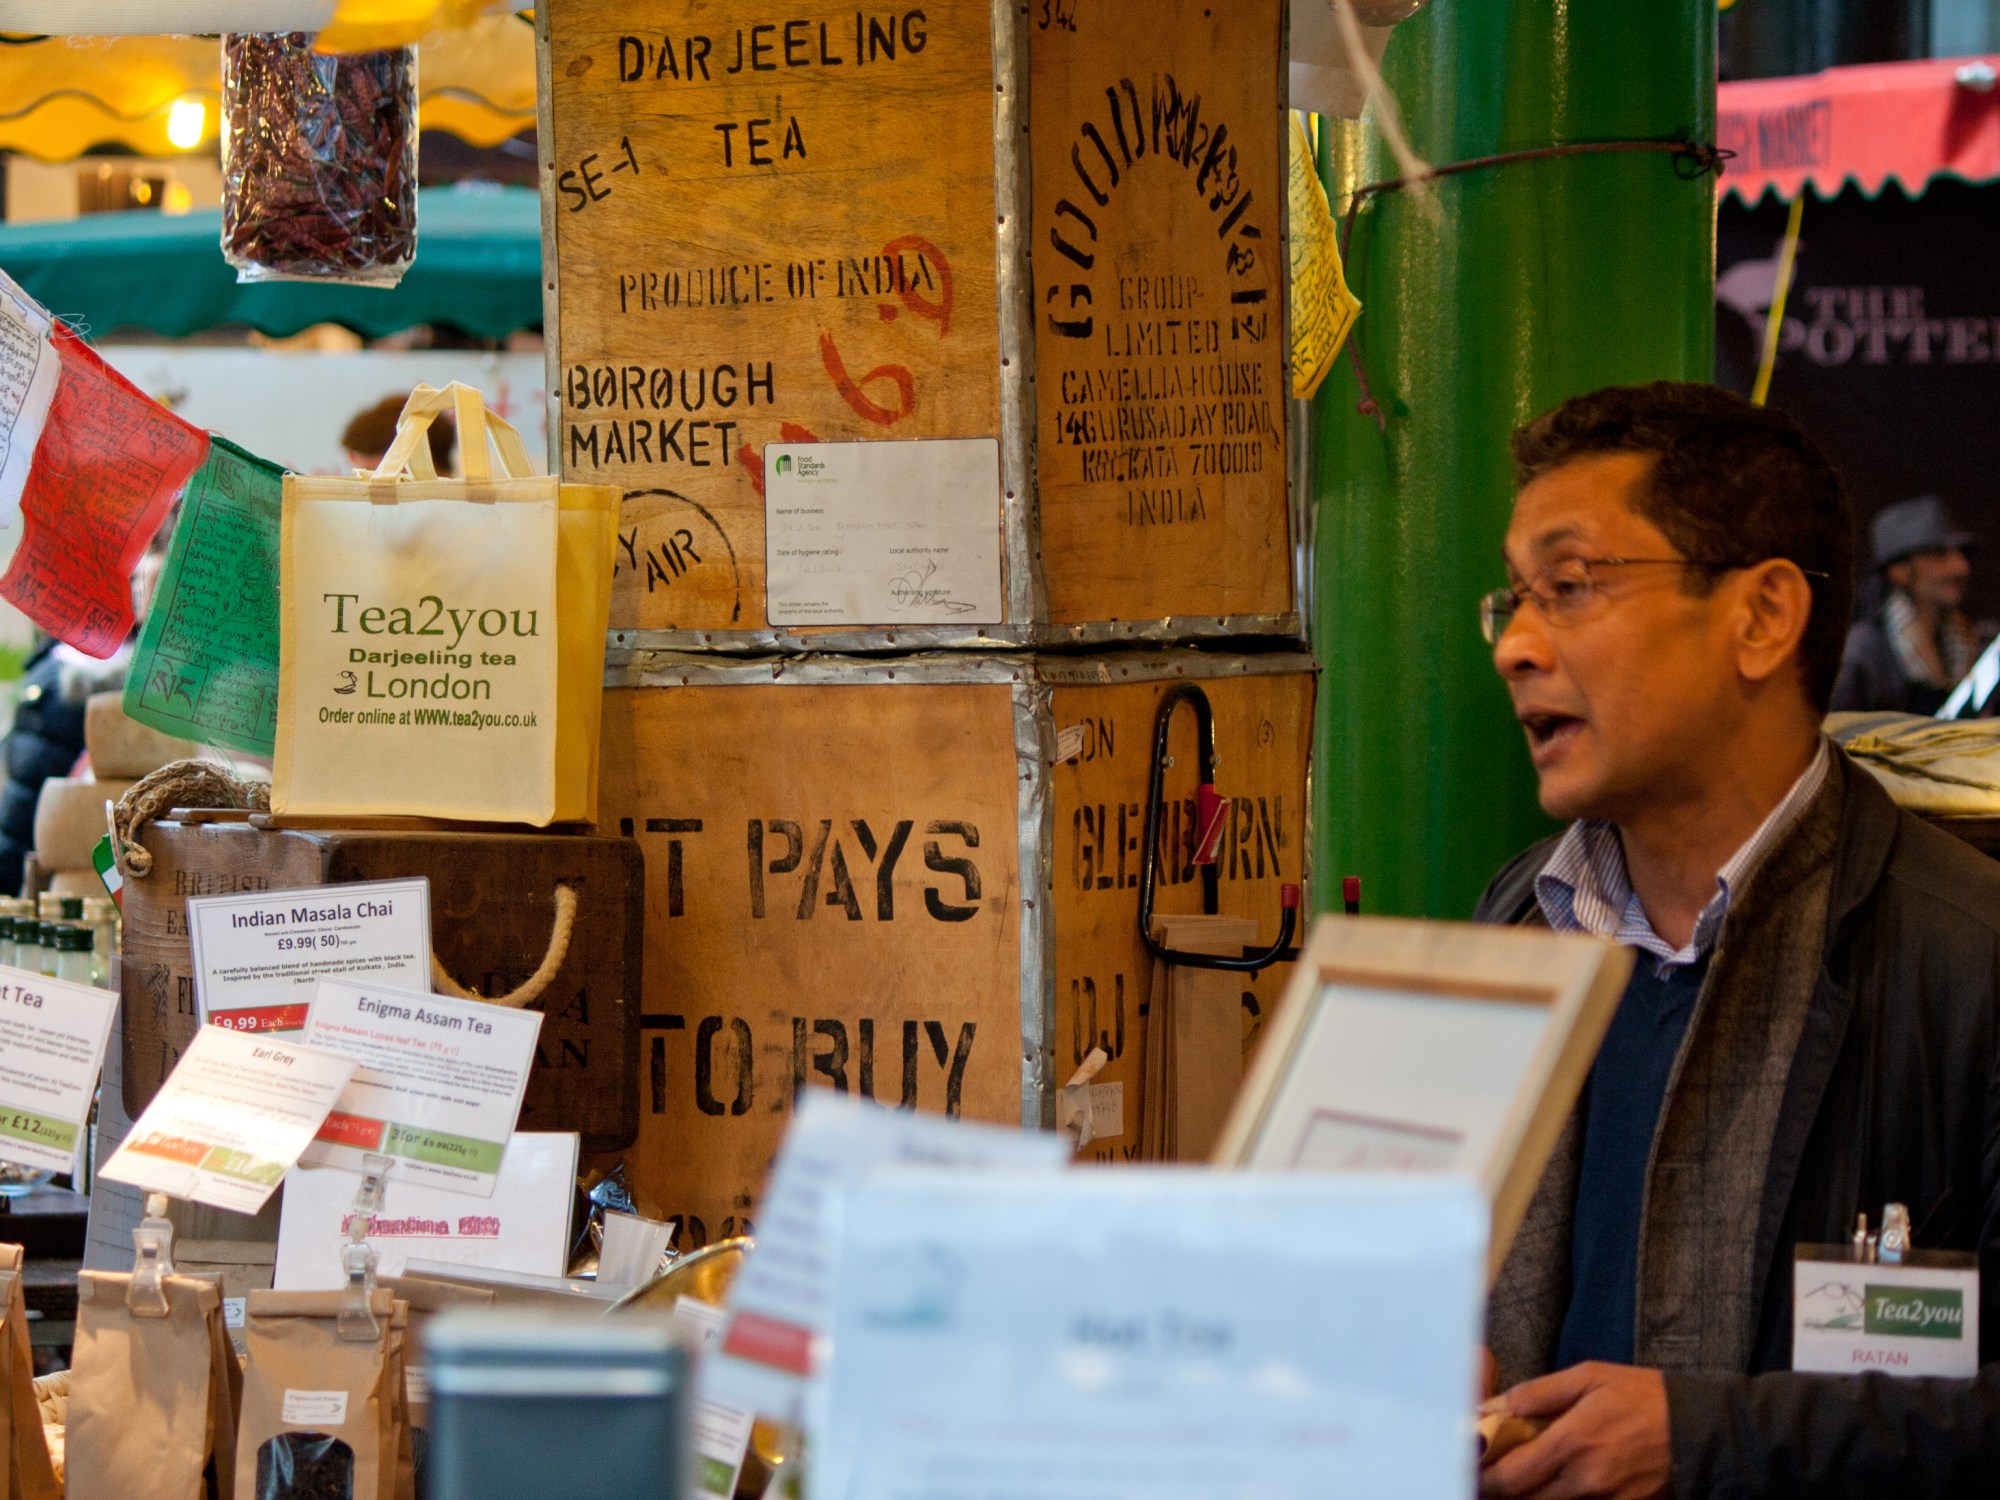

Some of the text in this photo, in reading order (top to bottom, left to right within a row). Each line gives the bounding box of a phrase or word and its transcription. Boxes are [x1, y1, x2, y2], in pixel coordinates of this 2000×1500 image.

[618, 9, 928, 82] DARJEELING
[714, 116, 807, 168] TEA
[558, 136, 640, 213] SE-1
[619, 253, 934, 313] PRODUCE OF INDIA
[1805, 285, 1925, 319] THE
[1106, 320, 1219, 357] LIMITED
[1757, 315, 2000, 367] POTTE
[567, 361, 775, 412] BOROUGH
[1062, 362, 1262, 404] CAMELLIA HOUSE
[570, 419, 737, 469] MARKET
[797, 455, 813, 463] Food
[797, 469, 819, 477] Agency
[1082, 446, 1179, 483] KOLKATA
[1127, 487, 1206, 526] INDIA
[647, 528, 702, 593] AIR
[822, 548, 839, 556] rating
[906, 547, 931, 555] authority
[324, 594, 539, 650] Tea2you
[349, 648, 516, 668] Darjeeling tea
[367, 671, 490, 700] London
[318, 707, 537, 730] Order online at WWW.tea2you.co.uk
[747, 818, 982, 922] PAYS
[232, 900, 393, 929] Indian Masala Chai
[219, 967, 248, 975] carefully
[250, 964, 280, 972] balanced
[281, 962, 300, 970] blend
[310, 959, 344, 967] handmade
[346, 958, 366, 966] spices
[223, 974, 251, 982] Inspired
[275, 968, 310, 977] traditional
[311, 967, 331, 975] street
[293, 977, 315, 985] (North
[15, 986, 44, 1009] Tea
[213, 1016, 282, 1030] £9.99 Each
[342, 1025, 368, 1037] Assam
[358, 997, 493, 1035] Enigma Assam Tea
[252, 1047, 297, 1066] Earl Grey
[640, 1014, 753, 1116] TO
[792, 1016, 976, 1122] BUY
[1874, 1297, 1963, 1326] Tea2you
[1852, 1350, 1909, 1366] RATAN
